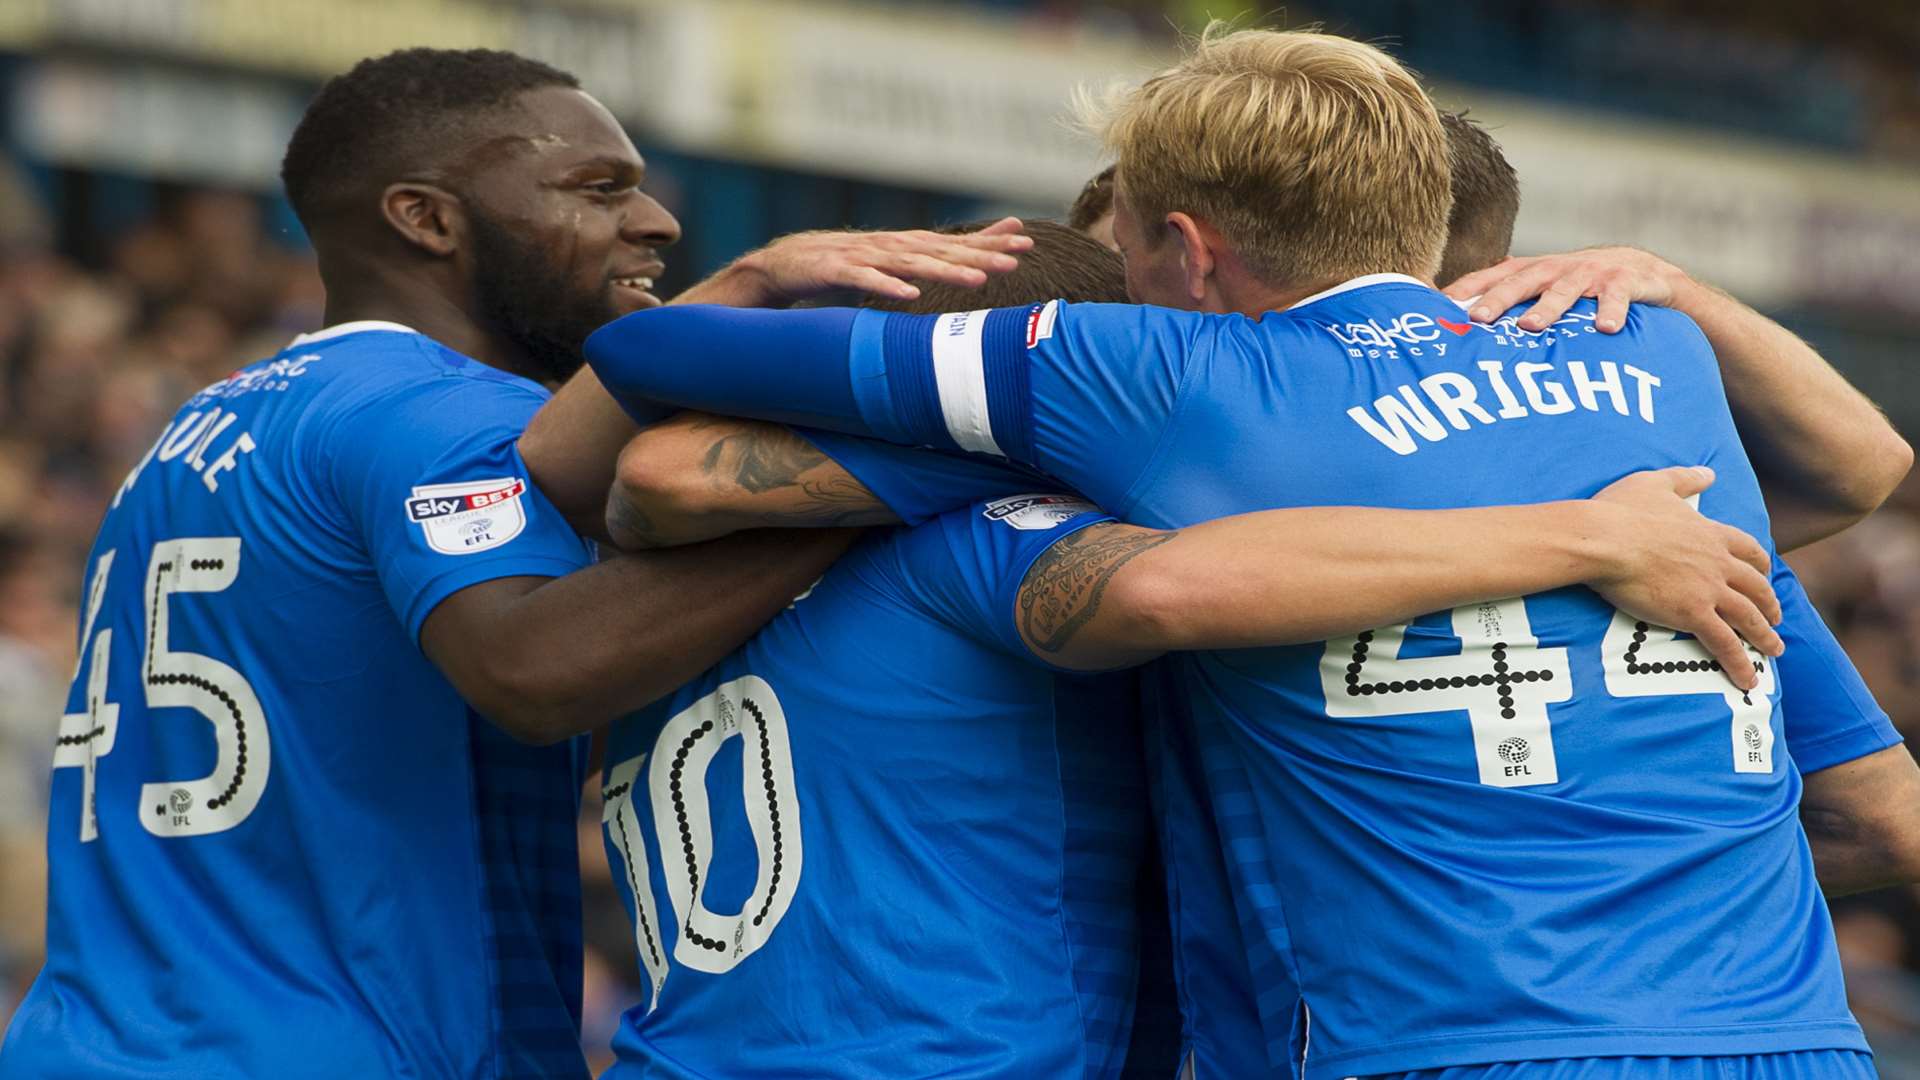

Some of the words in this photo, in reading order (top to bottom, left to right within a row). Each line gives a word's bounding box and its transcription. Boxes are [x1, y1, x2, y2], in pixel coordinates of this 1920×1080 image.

[1348, 343, 1447, 359] mercy
[1495, 325, 1597, 349] missio
[1346, 360, 1661, 456] WRIGHT
[415, 499, 460, 517] sky
[471, 484, 518, 508] BET
[465, 533, 494, 546] EFL
[1319, 493, 1775, 787] 44
[53, 535, 271, 843] 45
[1504, 764, 1532, 777] EFL
[1748, 751, 1763, 763] EFL
[601, 674, 803, 1017] 10
